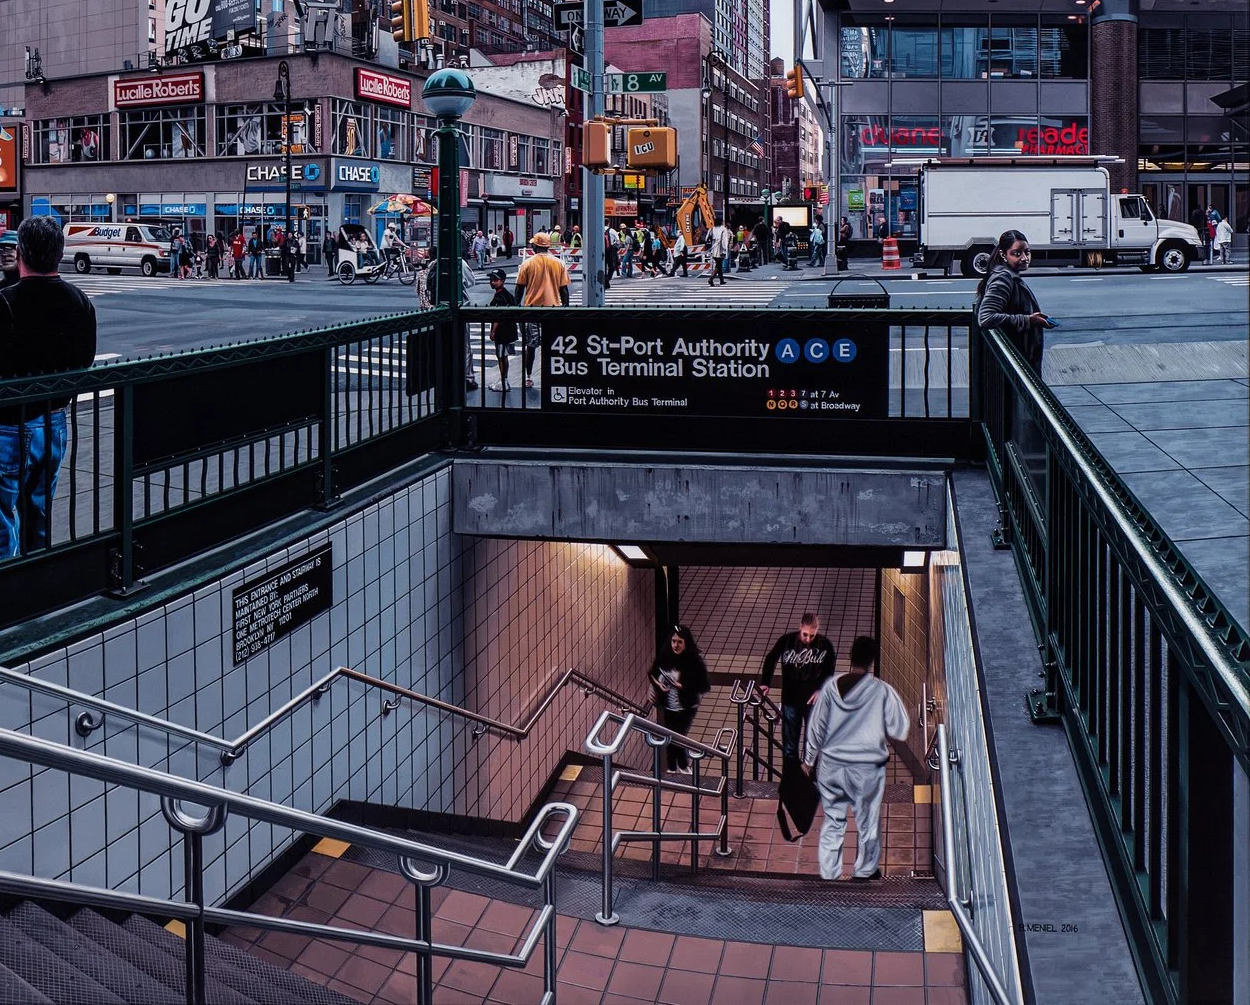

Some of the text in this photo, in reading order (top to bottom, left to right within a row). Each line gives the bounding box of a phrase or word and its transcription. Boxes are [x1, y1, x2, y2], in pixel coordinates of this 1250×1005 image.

[567, 7, 627, 22] ON WAY
[166, 17, 213, 53] TIME
[116, 80, 200, 101] Lucille Roberts
[628, 74, 663, 92] 8 AV
[861, 122, 1088, 146] duane reade
[338, 165, 371, 182] CHASE
[164, 206, 189, 214] CHASE
[240, 206, 266, 214] CHASE
[94, 226, 122, 238] Budget
[550, 335, 578, 354] 42
[672, 338, 770, 361] Authority
[781, 344, 794, 358] A
[810, 342, 824, 358] C
[839, 343, 850, 357] E
[550, 356, 770, 378] Bus Terminal Station
[568, 386, 615, 396] Elevator in
[810, 390, 818, 398] at
[820, 390, 826, 398] 7
[829, 390, 840, 398] Av
[568, 396, 688, 408] Port Authority Bus Terminal
[810, 402, 818, 410] at
[821, 402, 860, 412] Broadway
[236, 596, 248, 608] THIS
[250, 581, 278, 601] ENTRANCE
[280, 573, 292, 586] AND
[316, 558, 322, 567] IS
[236, 596, 269, 618] MAINTAINED
[236, 584, 308, 630] FIRST NEW YORK PARTNERS
[236, 587, 319, 640] ONE METROTECH CENTER NORTH
[236, 630, 264, 651] BROOKLYN
[266, 624, 274, 636] NY
[1061, 924, 1079, 933] 2016
